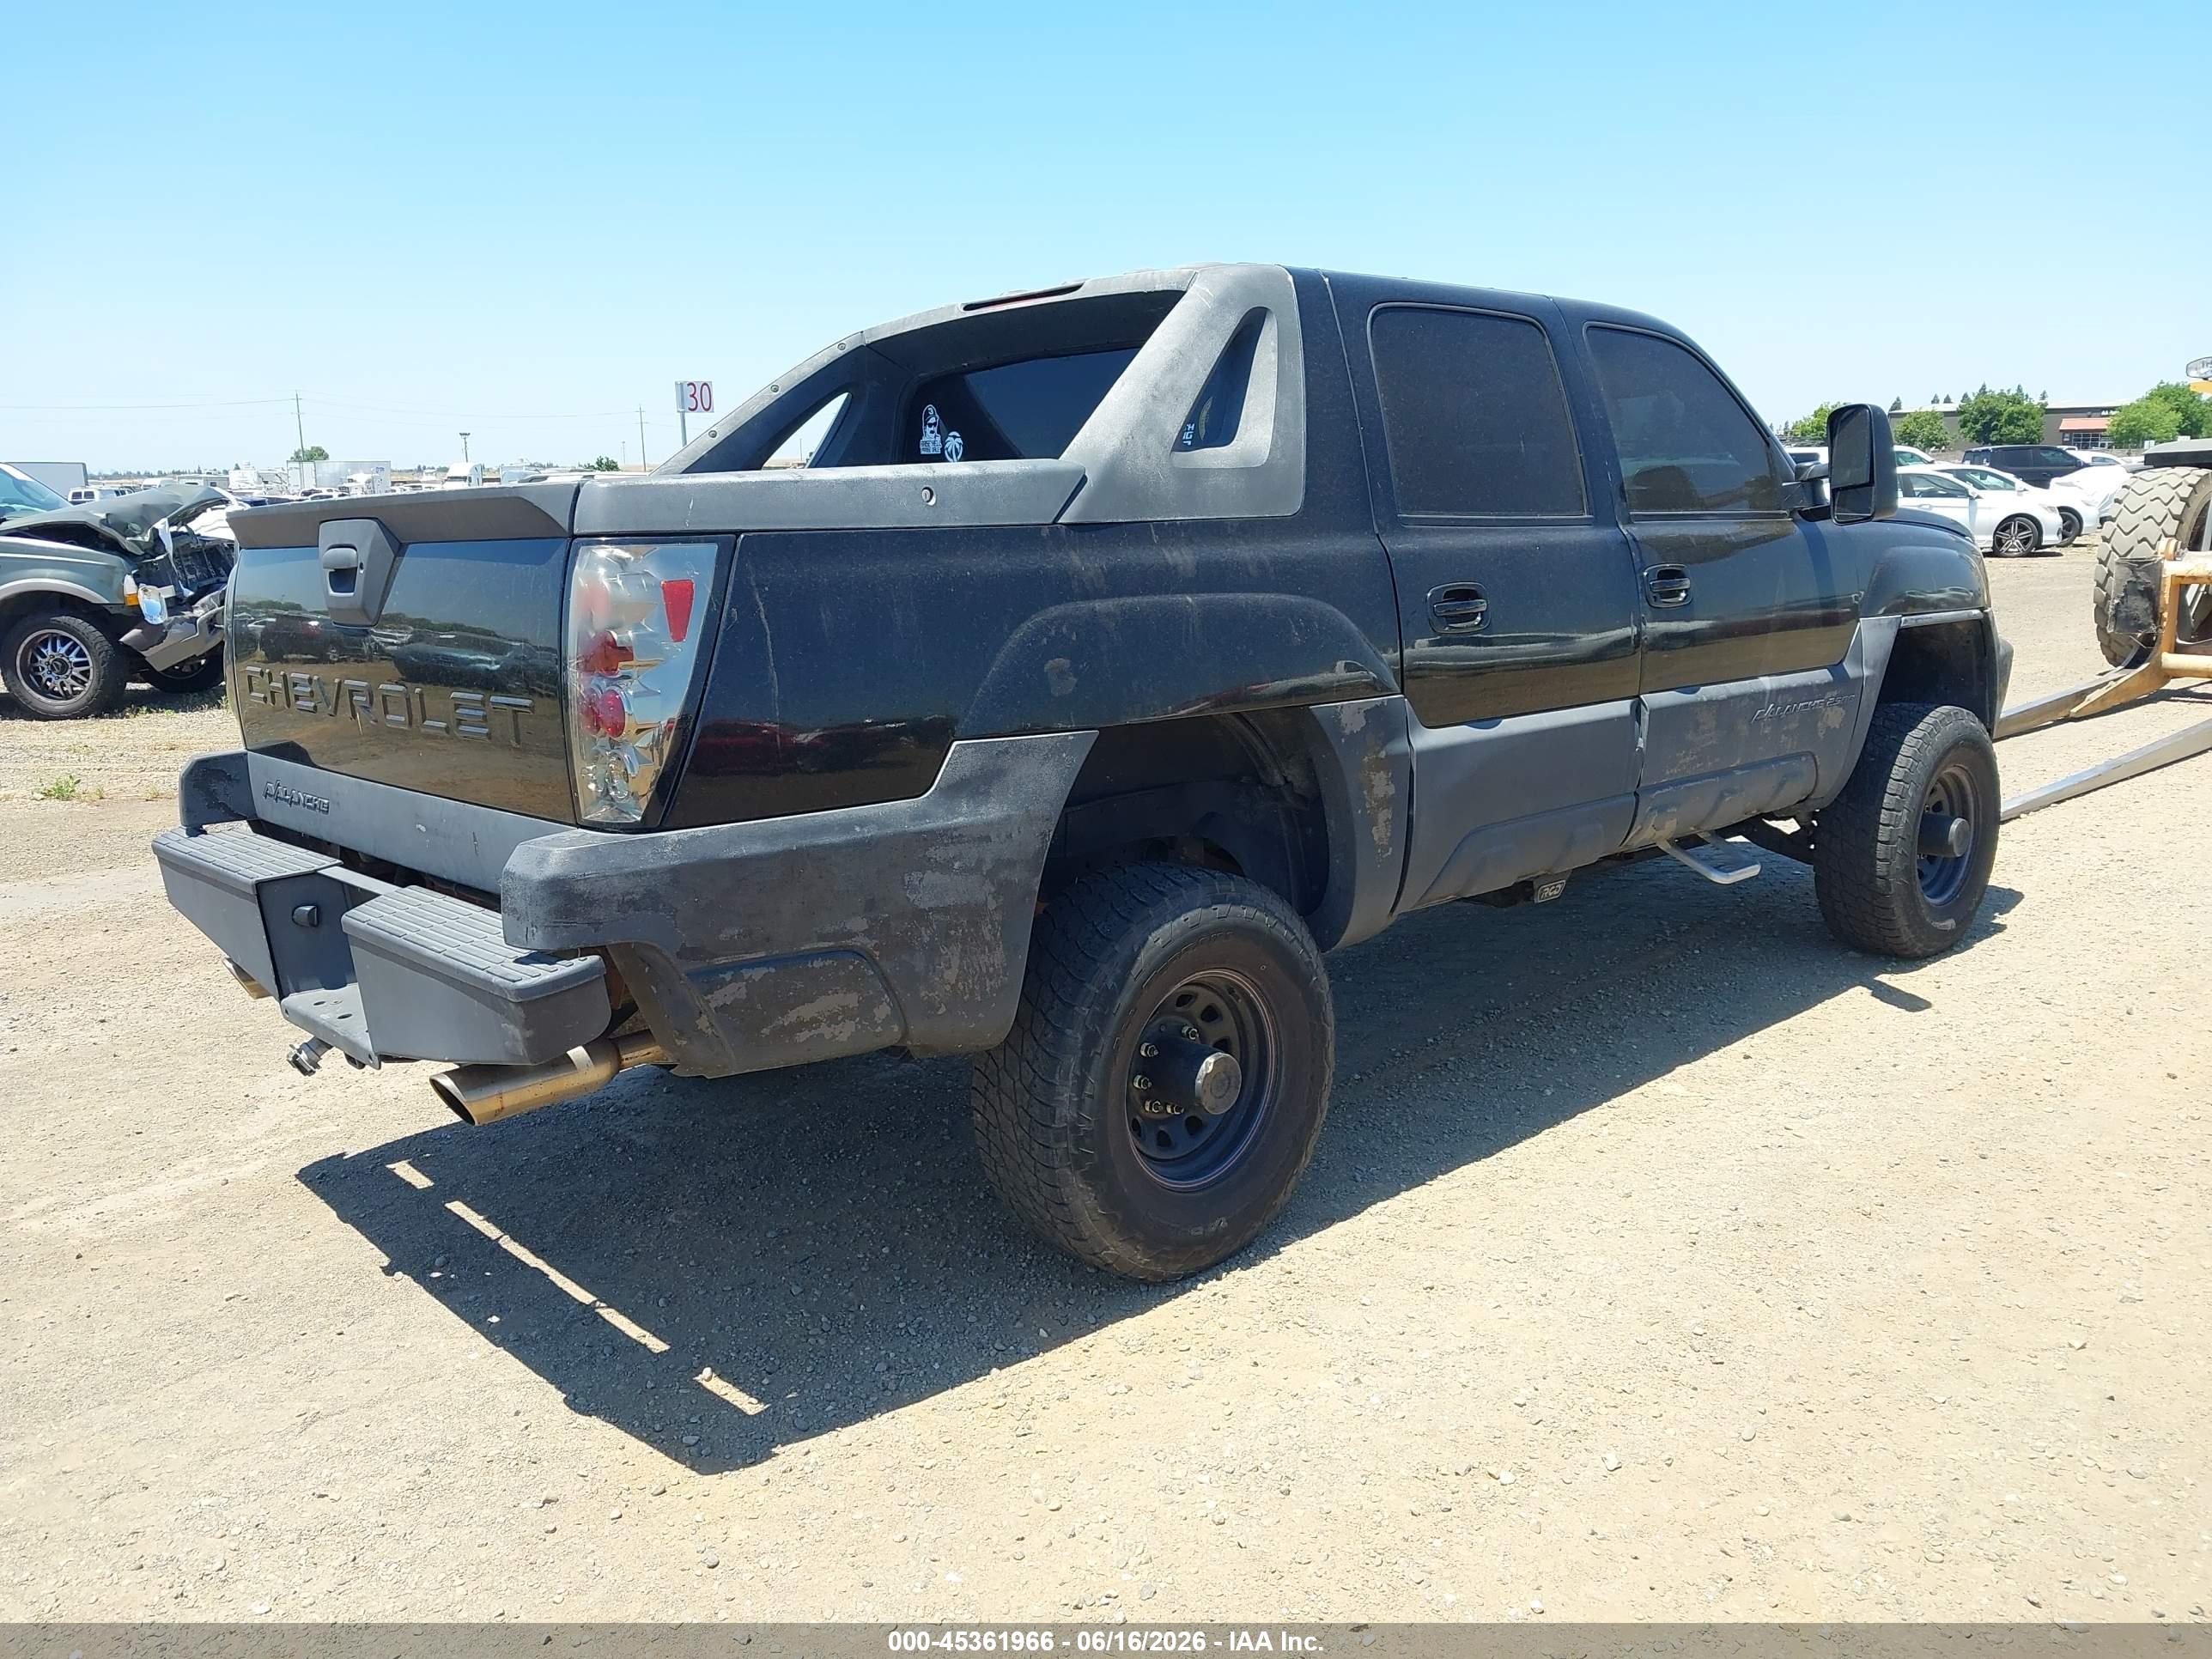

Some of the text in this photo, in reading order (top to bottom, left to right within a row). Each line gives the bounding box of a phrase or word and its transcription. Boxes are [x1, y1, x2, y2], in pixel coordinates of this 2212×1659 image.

[687, 382, 712, 412] 30
[245, 665, 535, 748] CHEVROLET
[1751, 699, 1825, 723] AVALANCHE
[263, 779, 330, 815] AVALANCHE
